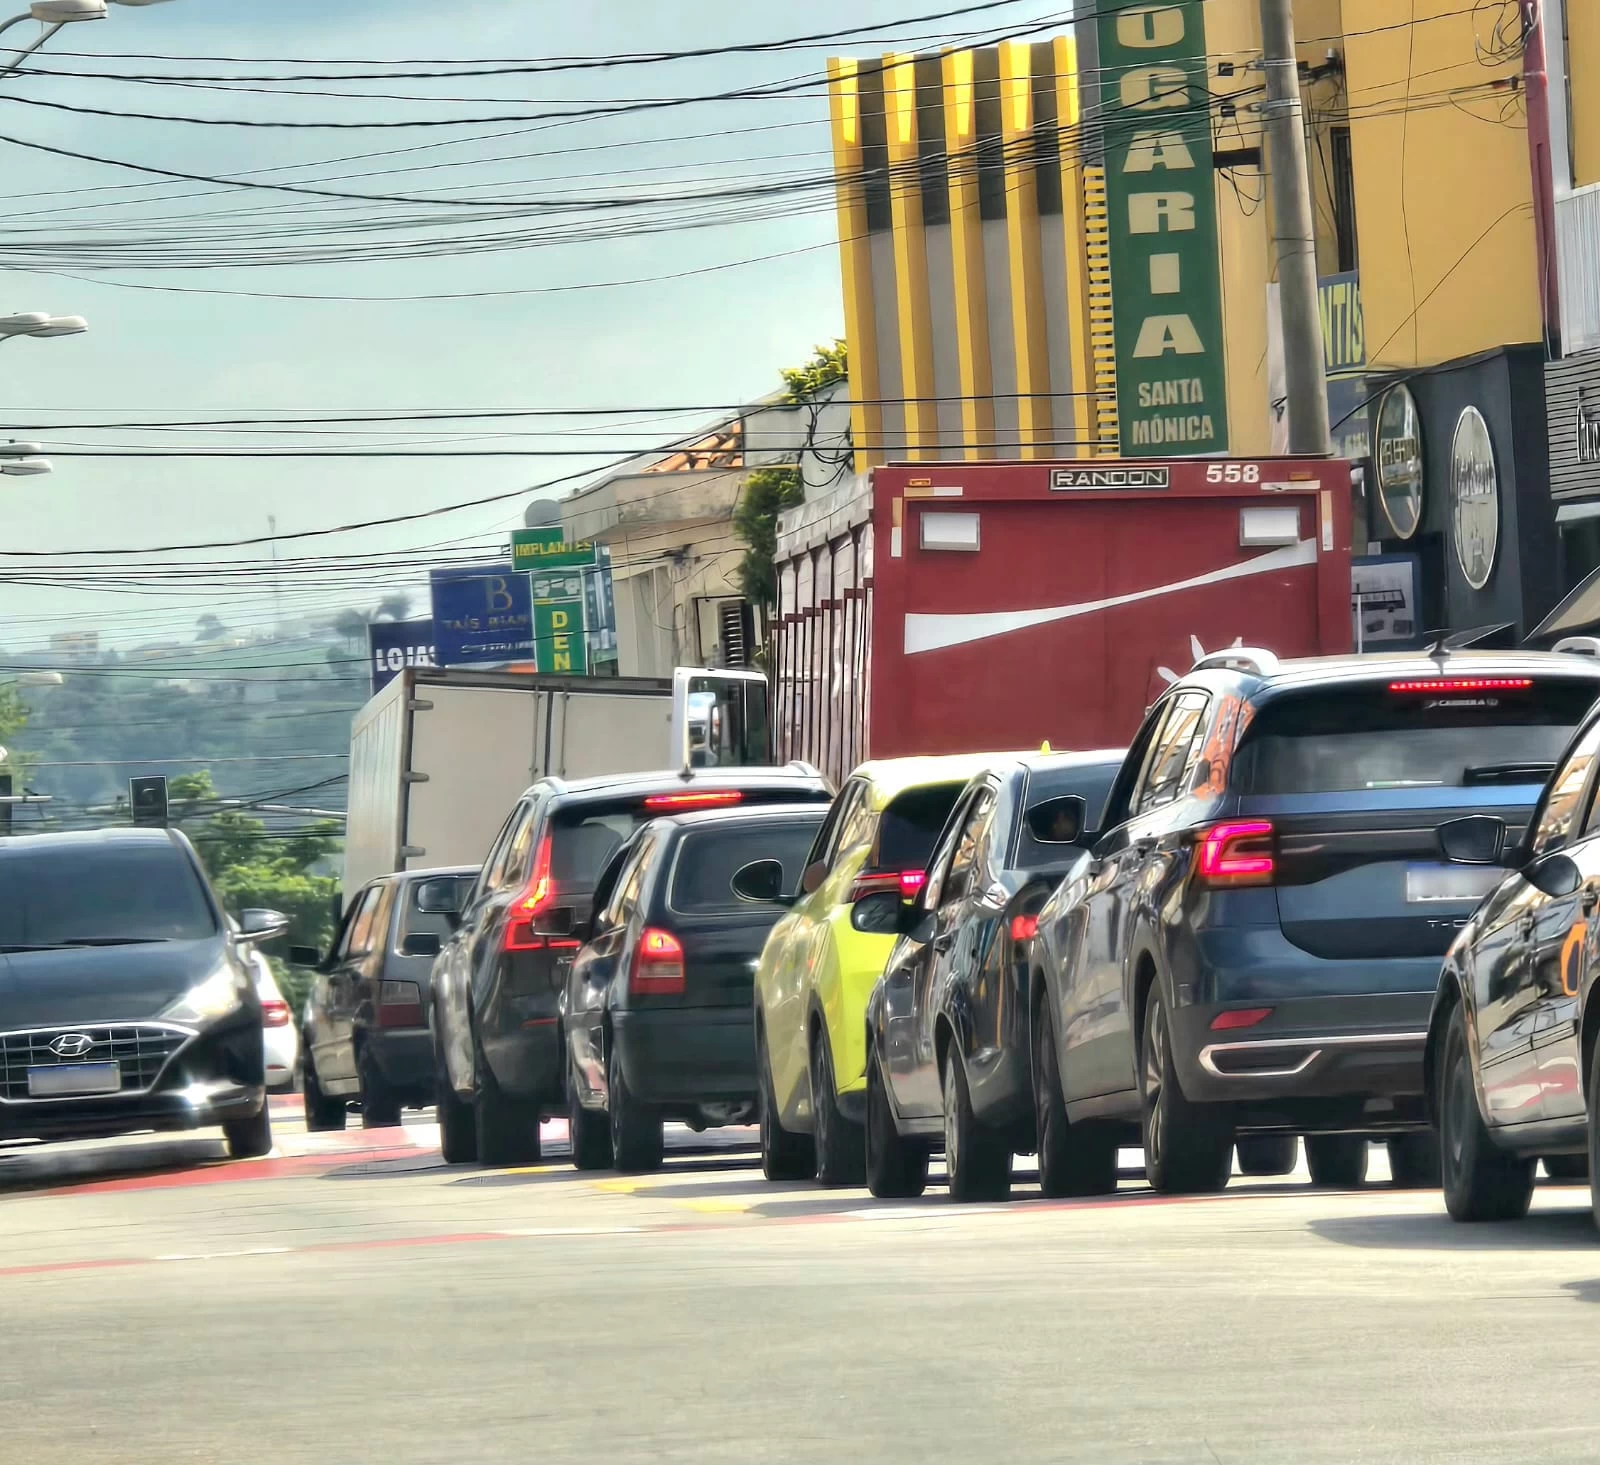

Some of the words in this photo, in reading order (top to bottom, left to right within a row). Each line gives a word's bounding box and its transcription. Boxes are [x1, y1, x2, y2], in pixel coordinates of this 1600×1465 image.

[1138, 378, 1204, 407] SANTA
[1056, 470, 1164, 487] RANDON
[1206, 464, 1260, 483] 558
